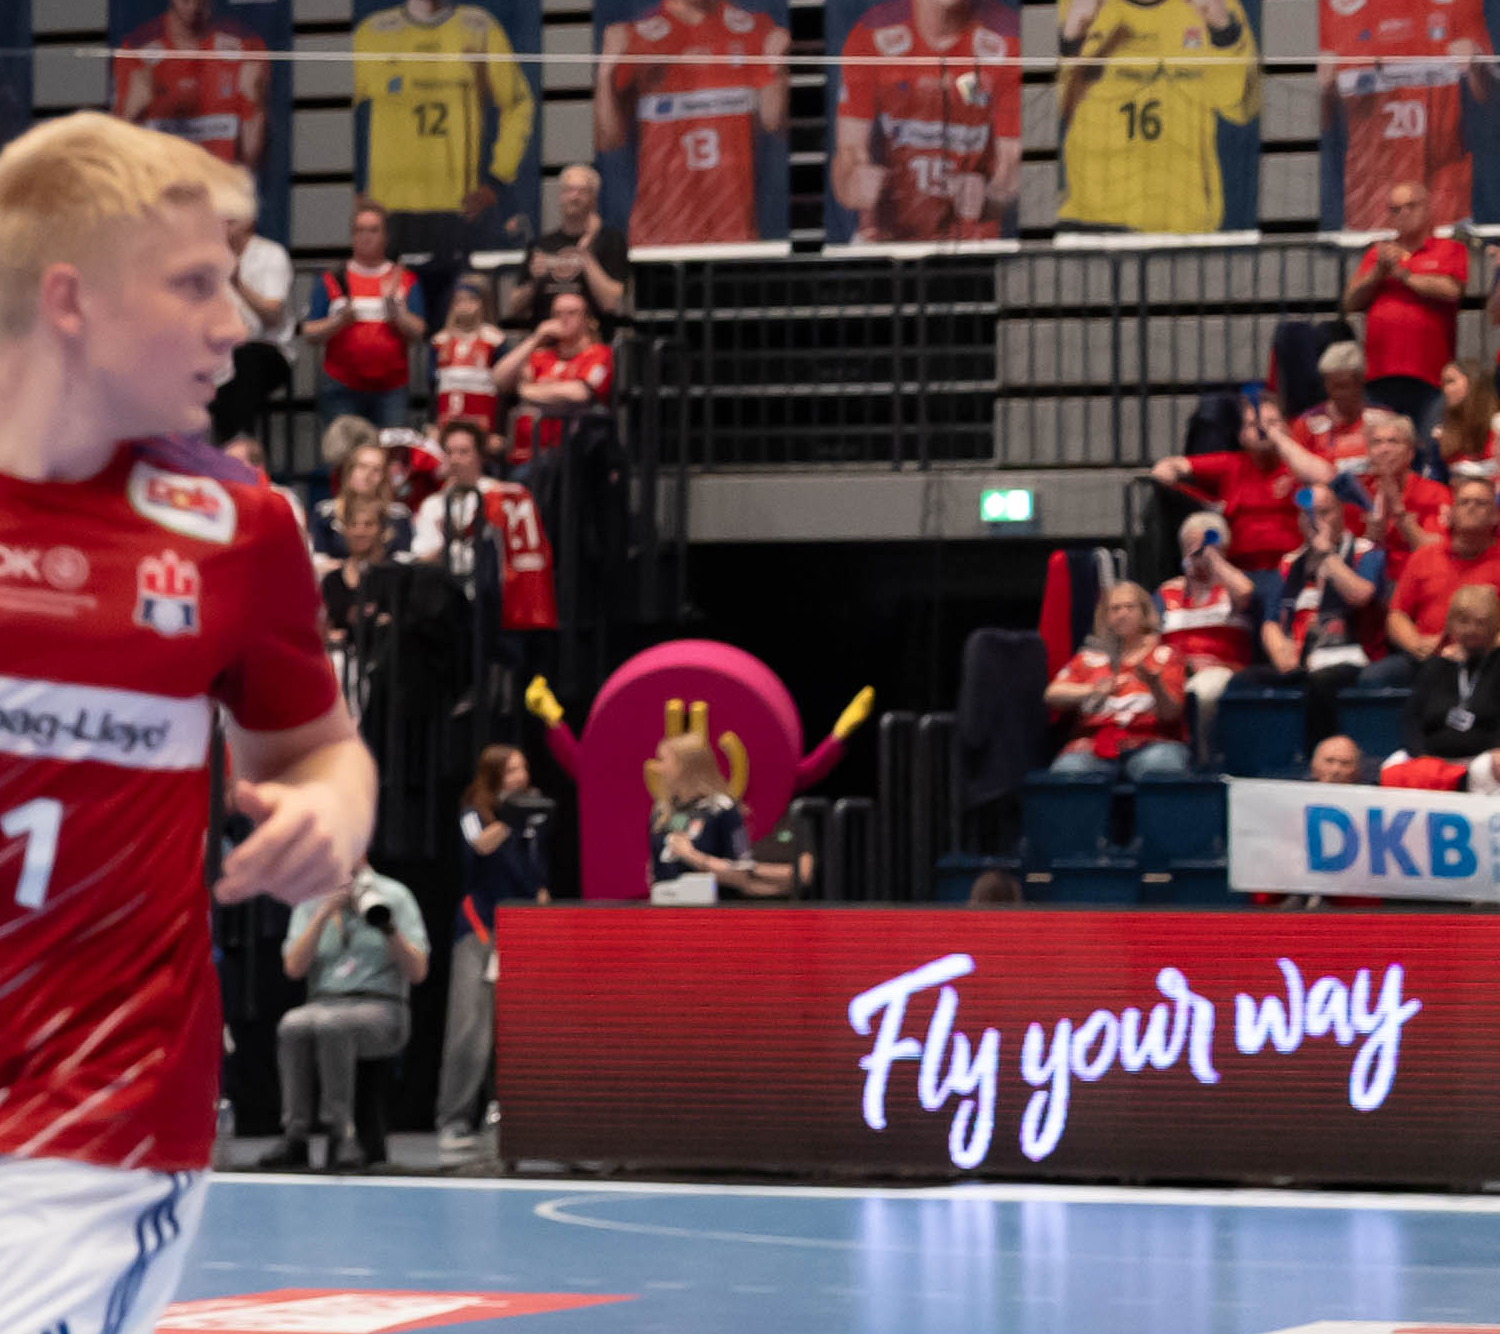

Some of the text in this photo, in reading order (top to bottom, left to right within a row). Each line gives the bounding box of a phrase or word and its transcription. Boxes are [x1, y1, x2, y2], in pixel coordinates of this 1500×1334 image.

[413, 101, 449, 138] 12
[1118, 99, 1164, 141] 16
[1380, 99, 1428, 139] 20
[680, 127, 721, 171] 13
[1303, 804, 1479, 880] DKB
[848, 952, 1422, 1170] Fly your way
